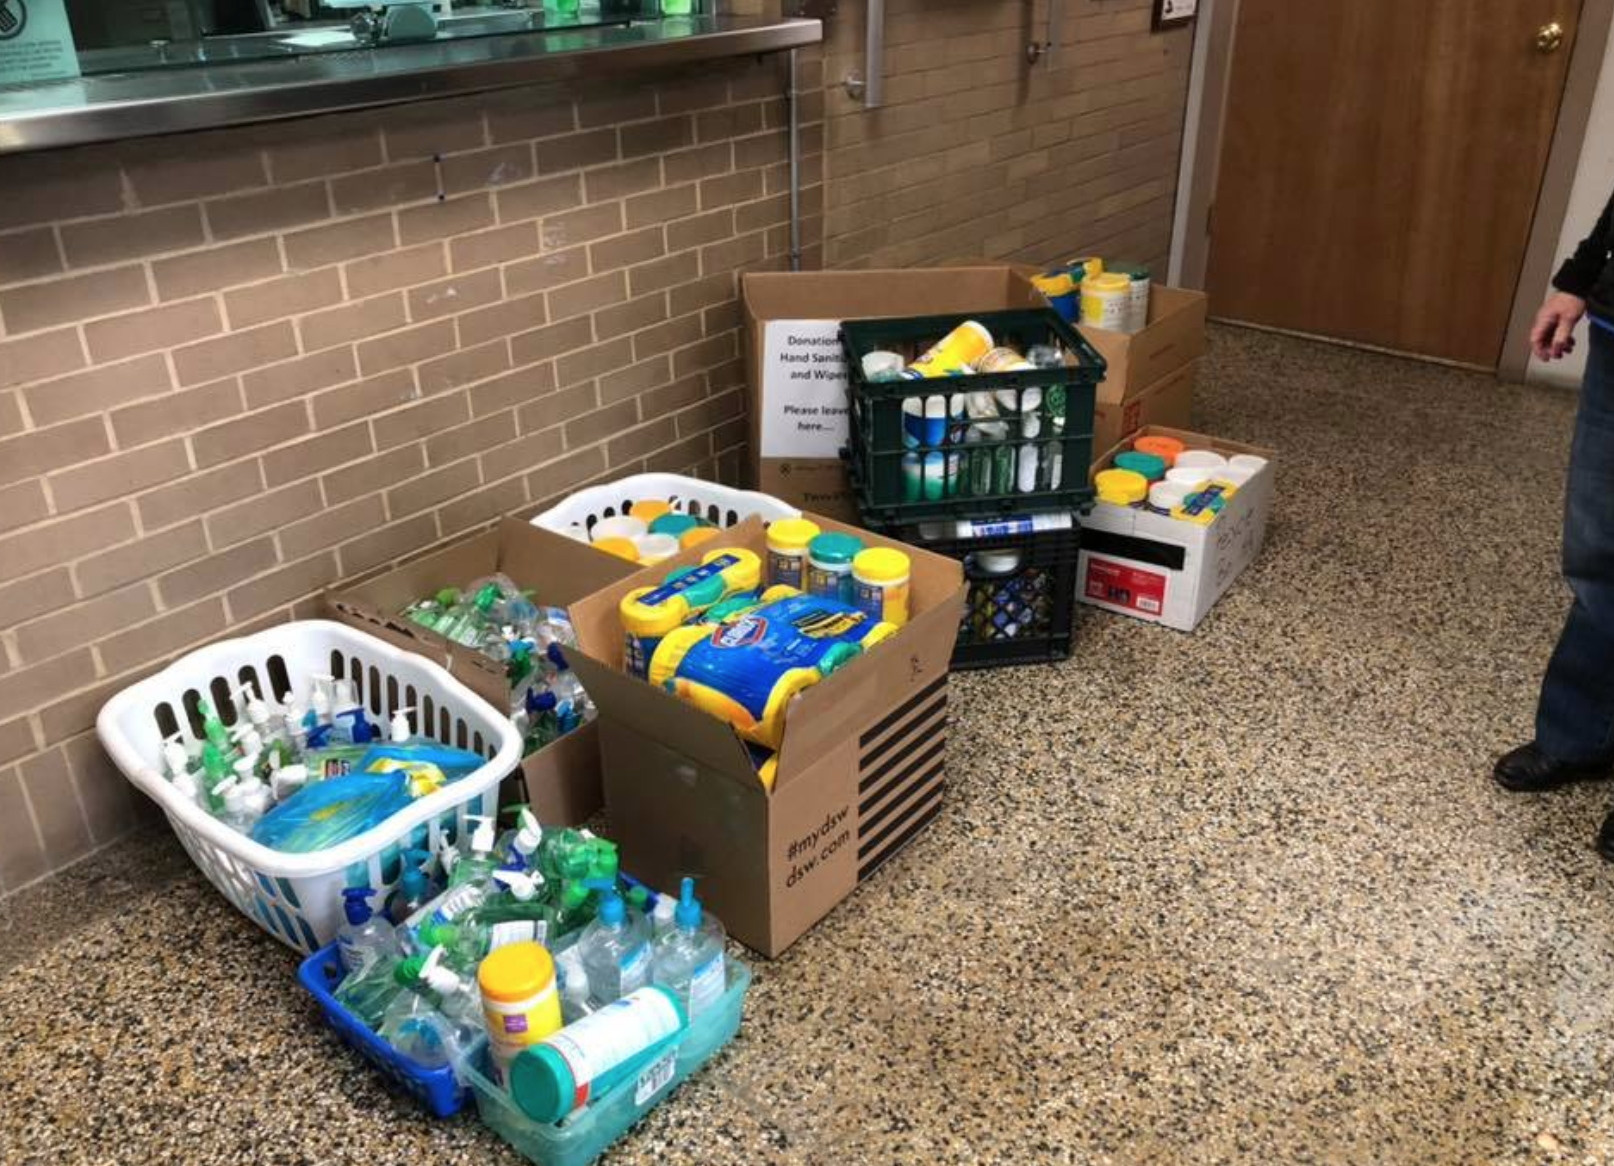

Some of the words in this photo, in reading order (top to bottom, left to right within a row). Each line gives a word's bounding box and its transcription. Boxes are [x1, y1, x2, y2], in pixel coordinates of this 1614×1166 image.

[788, 335, 839, 346] Donation
[780, 352, 809, 362] Hand
[790, 370, 811, 380] and
[783, 405, 819, 415] Please
[787, 804, 849, 861] #mydsw
[786, 830, 849, 888] dsw.com
